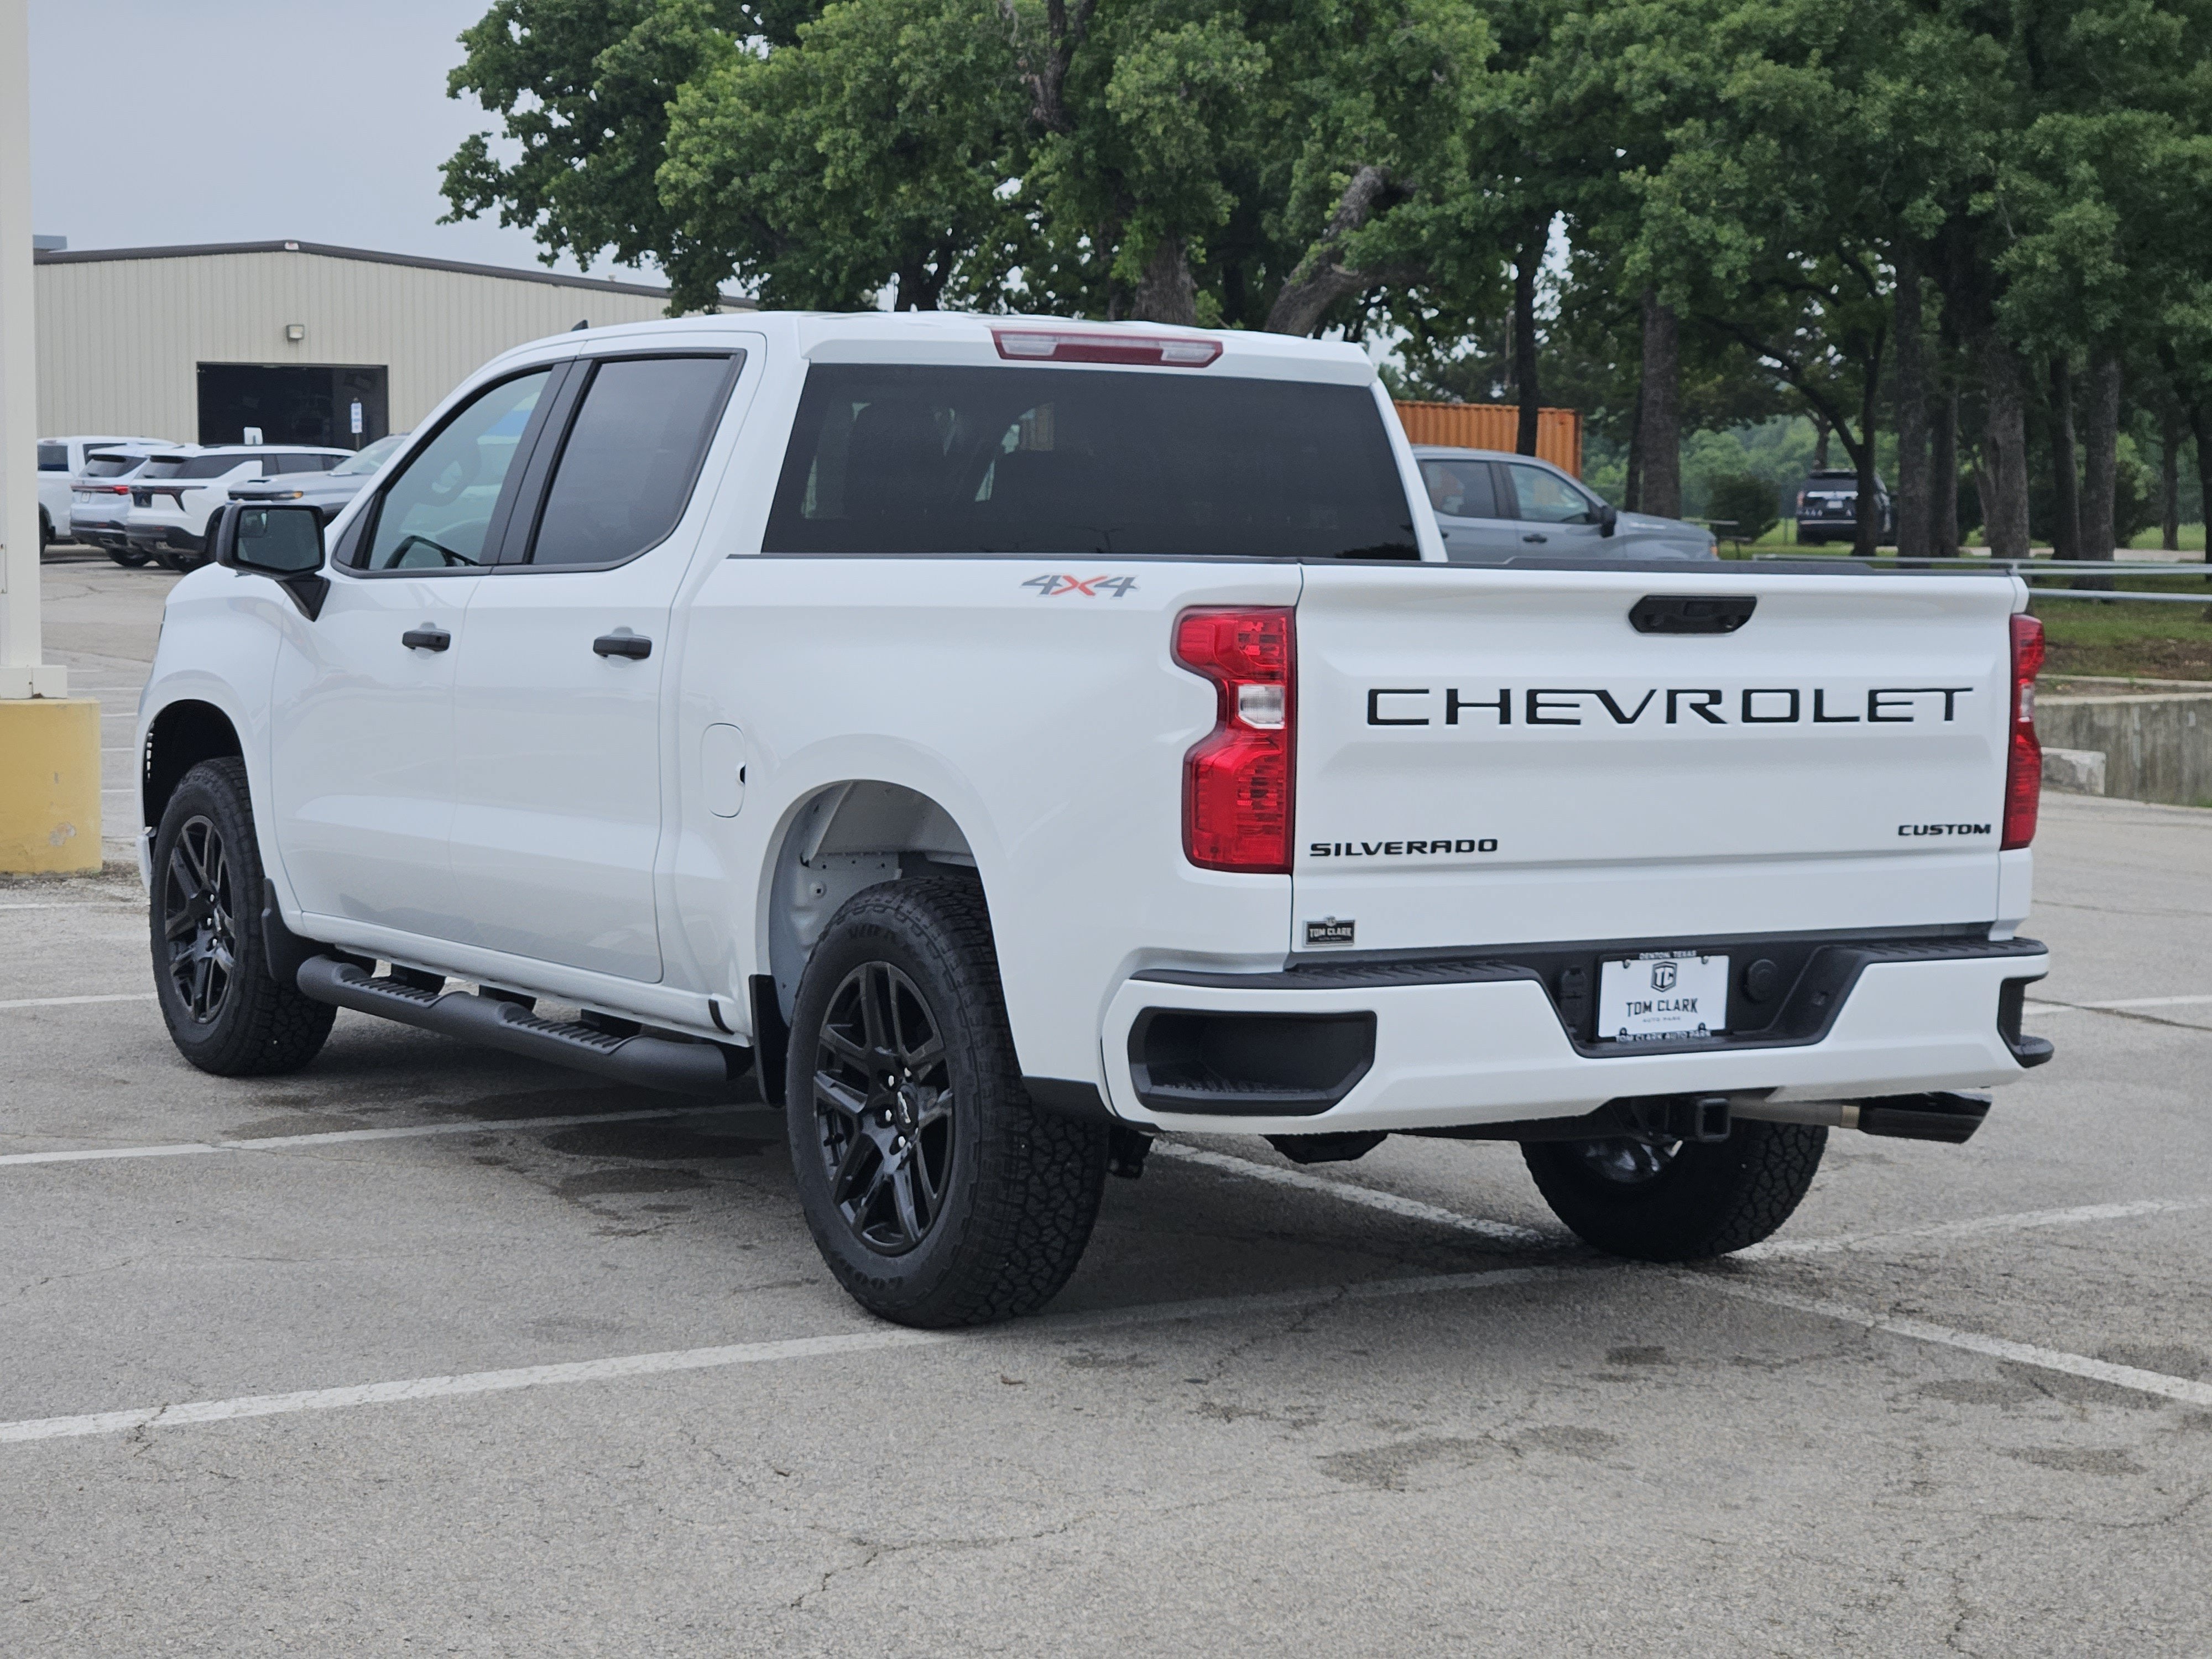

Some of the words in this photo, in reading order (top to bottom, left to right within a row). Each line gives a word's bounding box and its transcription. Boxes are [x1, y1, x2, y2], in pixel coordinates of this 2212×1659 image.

[1367, 687, 1974, 725] CHEVROLET
[1898, 823, 1991, 836] CUSTOM
[1310, 839, 1498, 857] SILVERADO
[1309, 928, 1326, 938] TOM
[1327, 927, 1352, 936] CLARK
[1626, 1000, 1652, 1018] TOM
[1657, 998, 1698, 1013] CLARK
